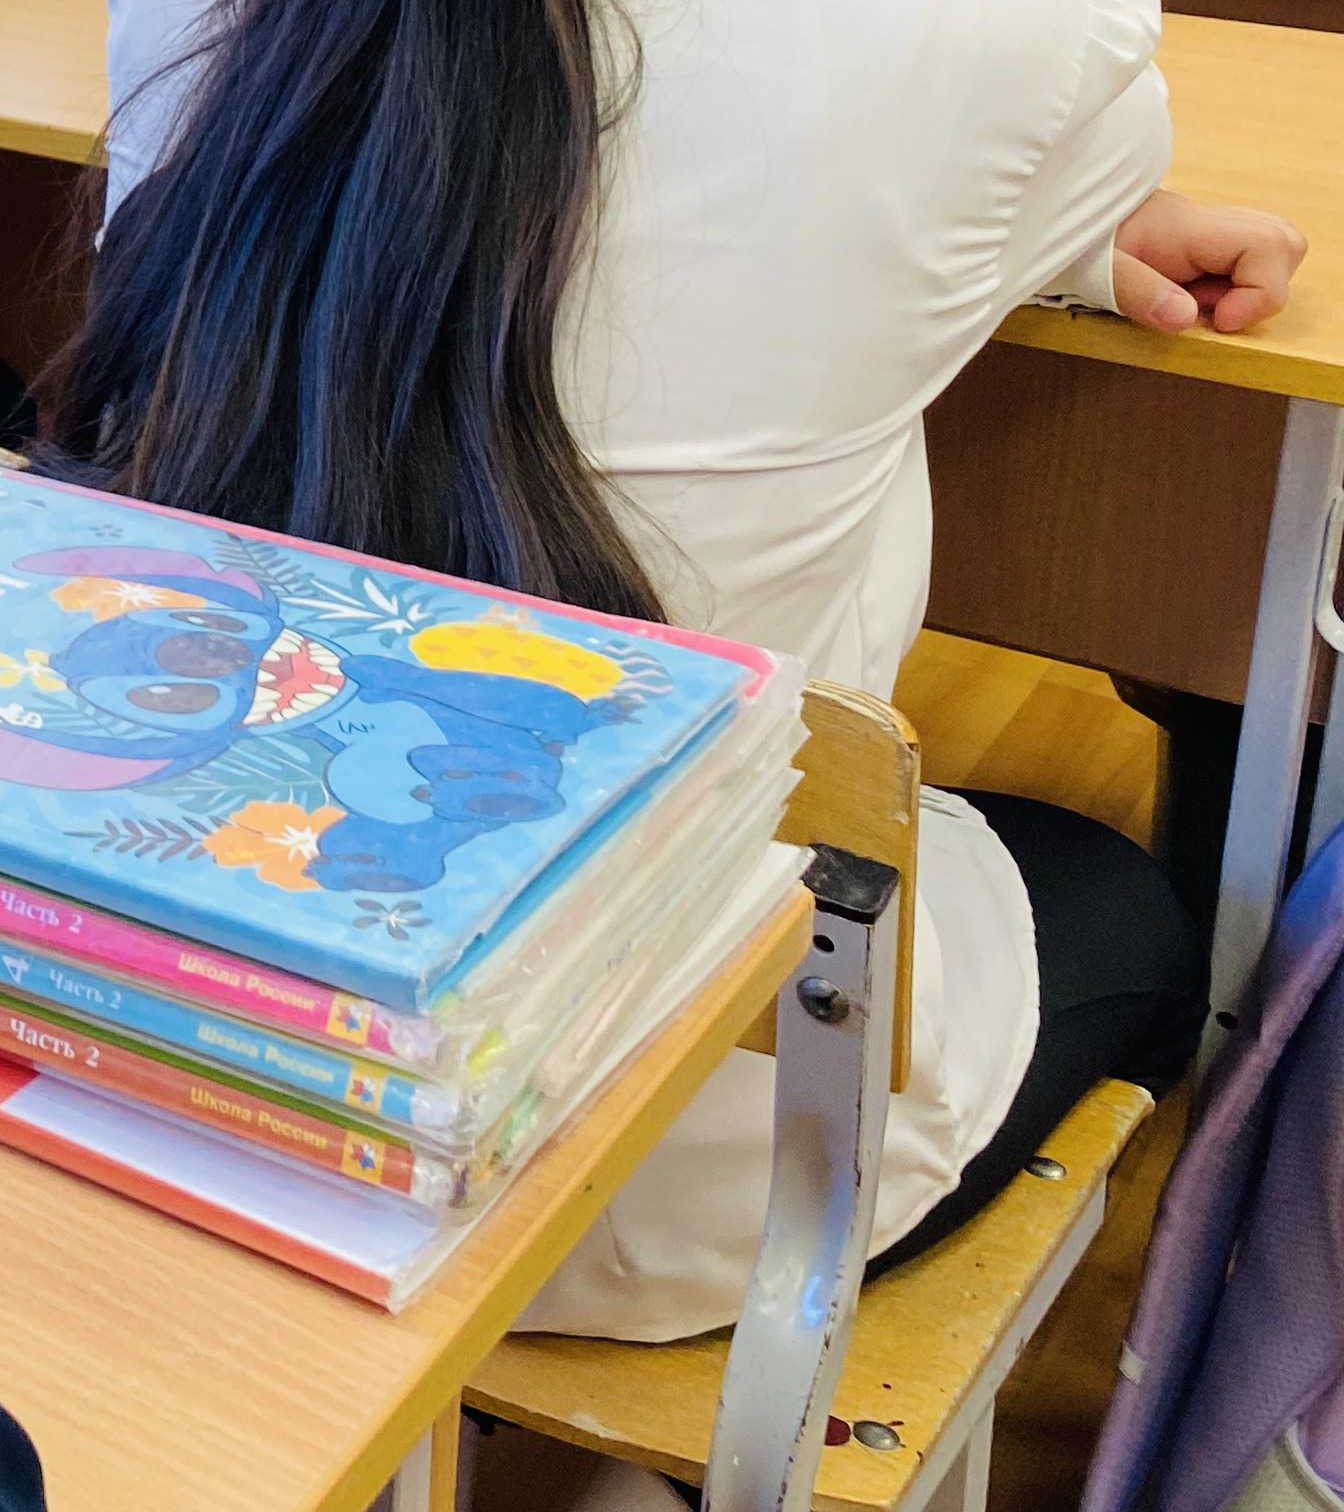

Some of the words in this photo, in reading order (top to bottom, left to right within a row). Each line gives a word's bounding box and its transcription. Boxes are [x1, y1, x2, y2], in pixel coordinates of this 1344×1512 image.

[0, 889, 60, 927] Часть
[68, 913, 83, 935] 2
[178, 951, 241, 988] Школа
[246, 974, 316, 1011] России
[49, 968, 105, 1004] Часть
[109, 991, 122, 1010] 2
[197, 1022, 259, 1059] Школа
[10, 1018, 76, 1060] Часть
[85, 1045, 100, 1068] 2
[190, 1086, 252, 1123] Школа
[258, 1110, 328, 1149] России
